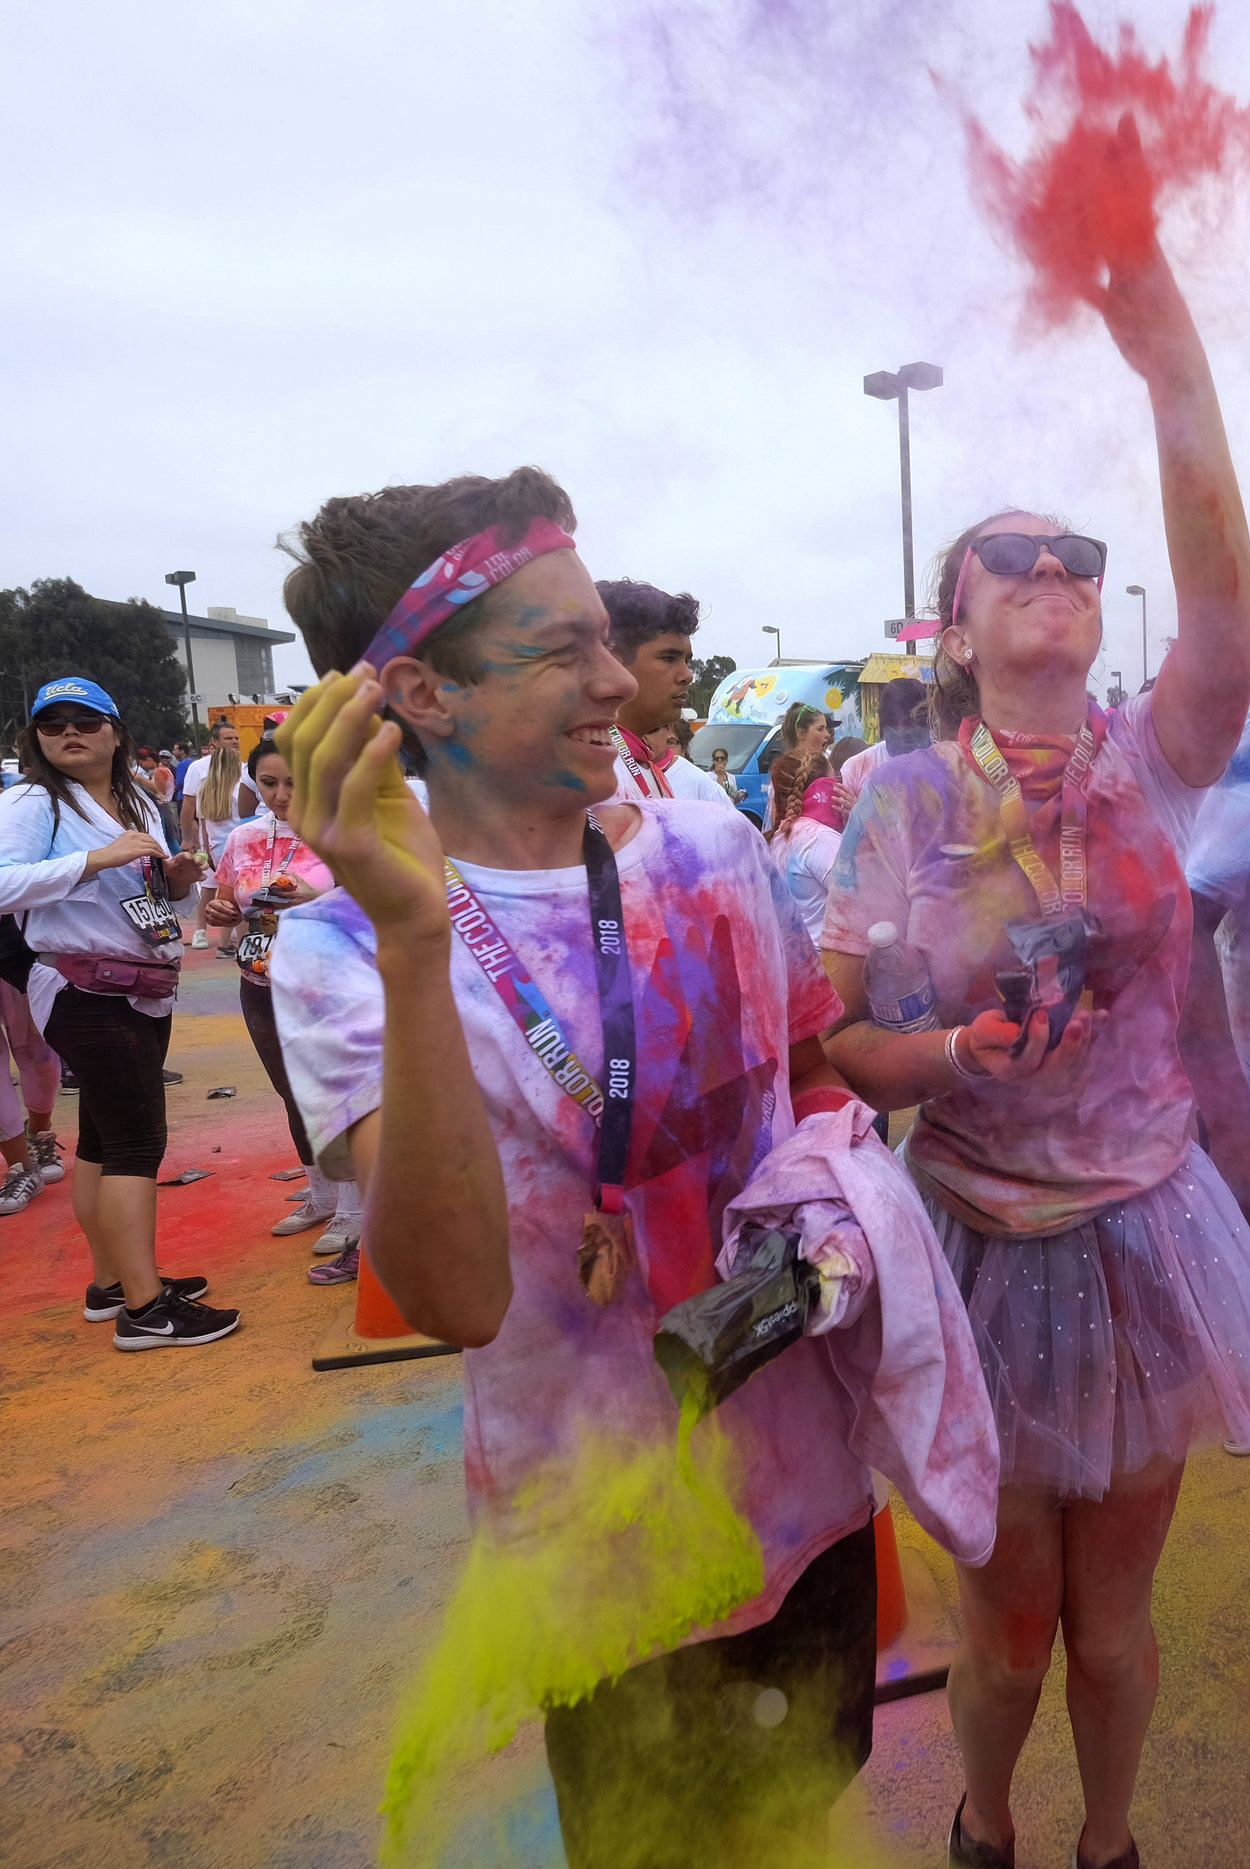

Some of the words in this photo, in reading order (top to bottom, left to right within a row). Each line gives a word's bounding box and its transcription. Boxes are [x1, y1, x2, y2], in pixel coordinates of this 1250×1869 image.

[625, 757, 641, 777] RUN
[1010, 832, 1040, 866] THE
[1061, 825, 1084, 858] RUN
[597, 918, 620, 956] 2018
[472, 938, 514, 984] THE
[525, 1017, 568, 1072] RUN
[552, 1060, 605, 1128] OLOR
[608, 1058, 630, 1099] 2018
